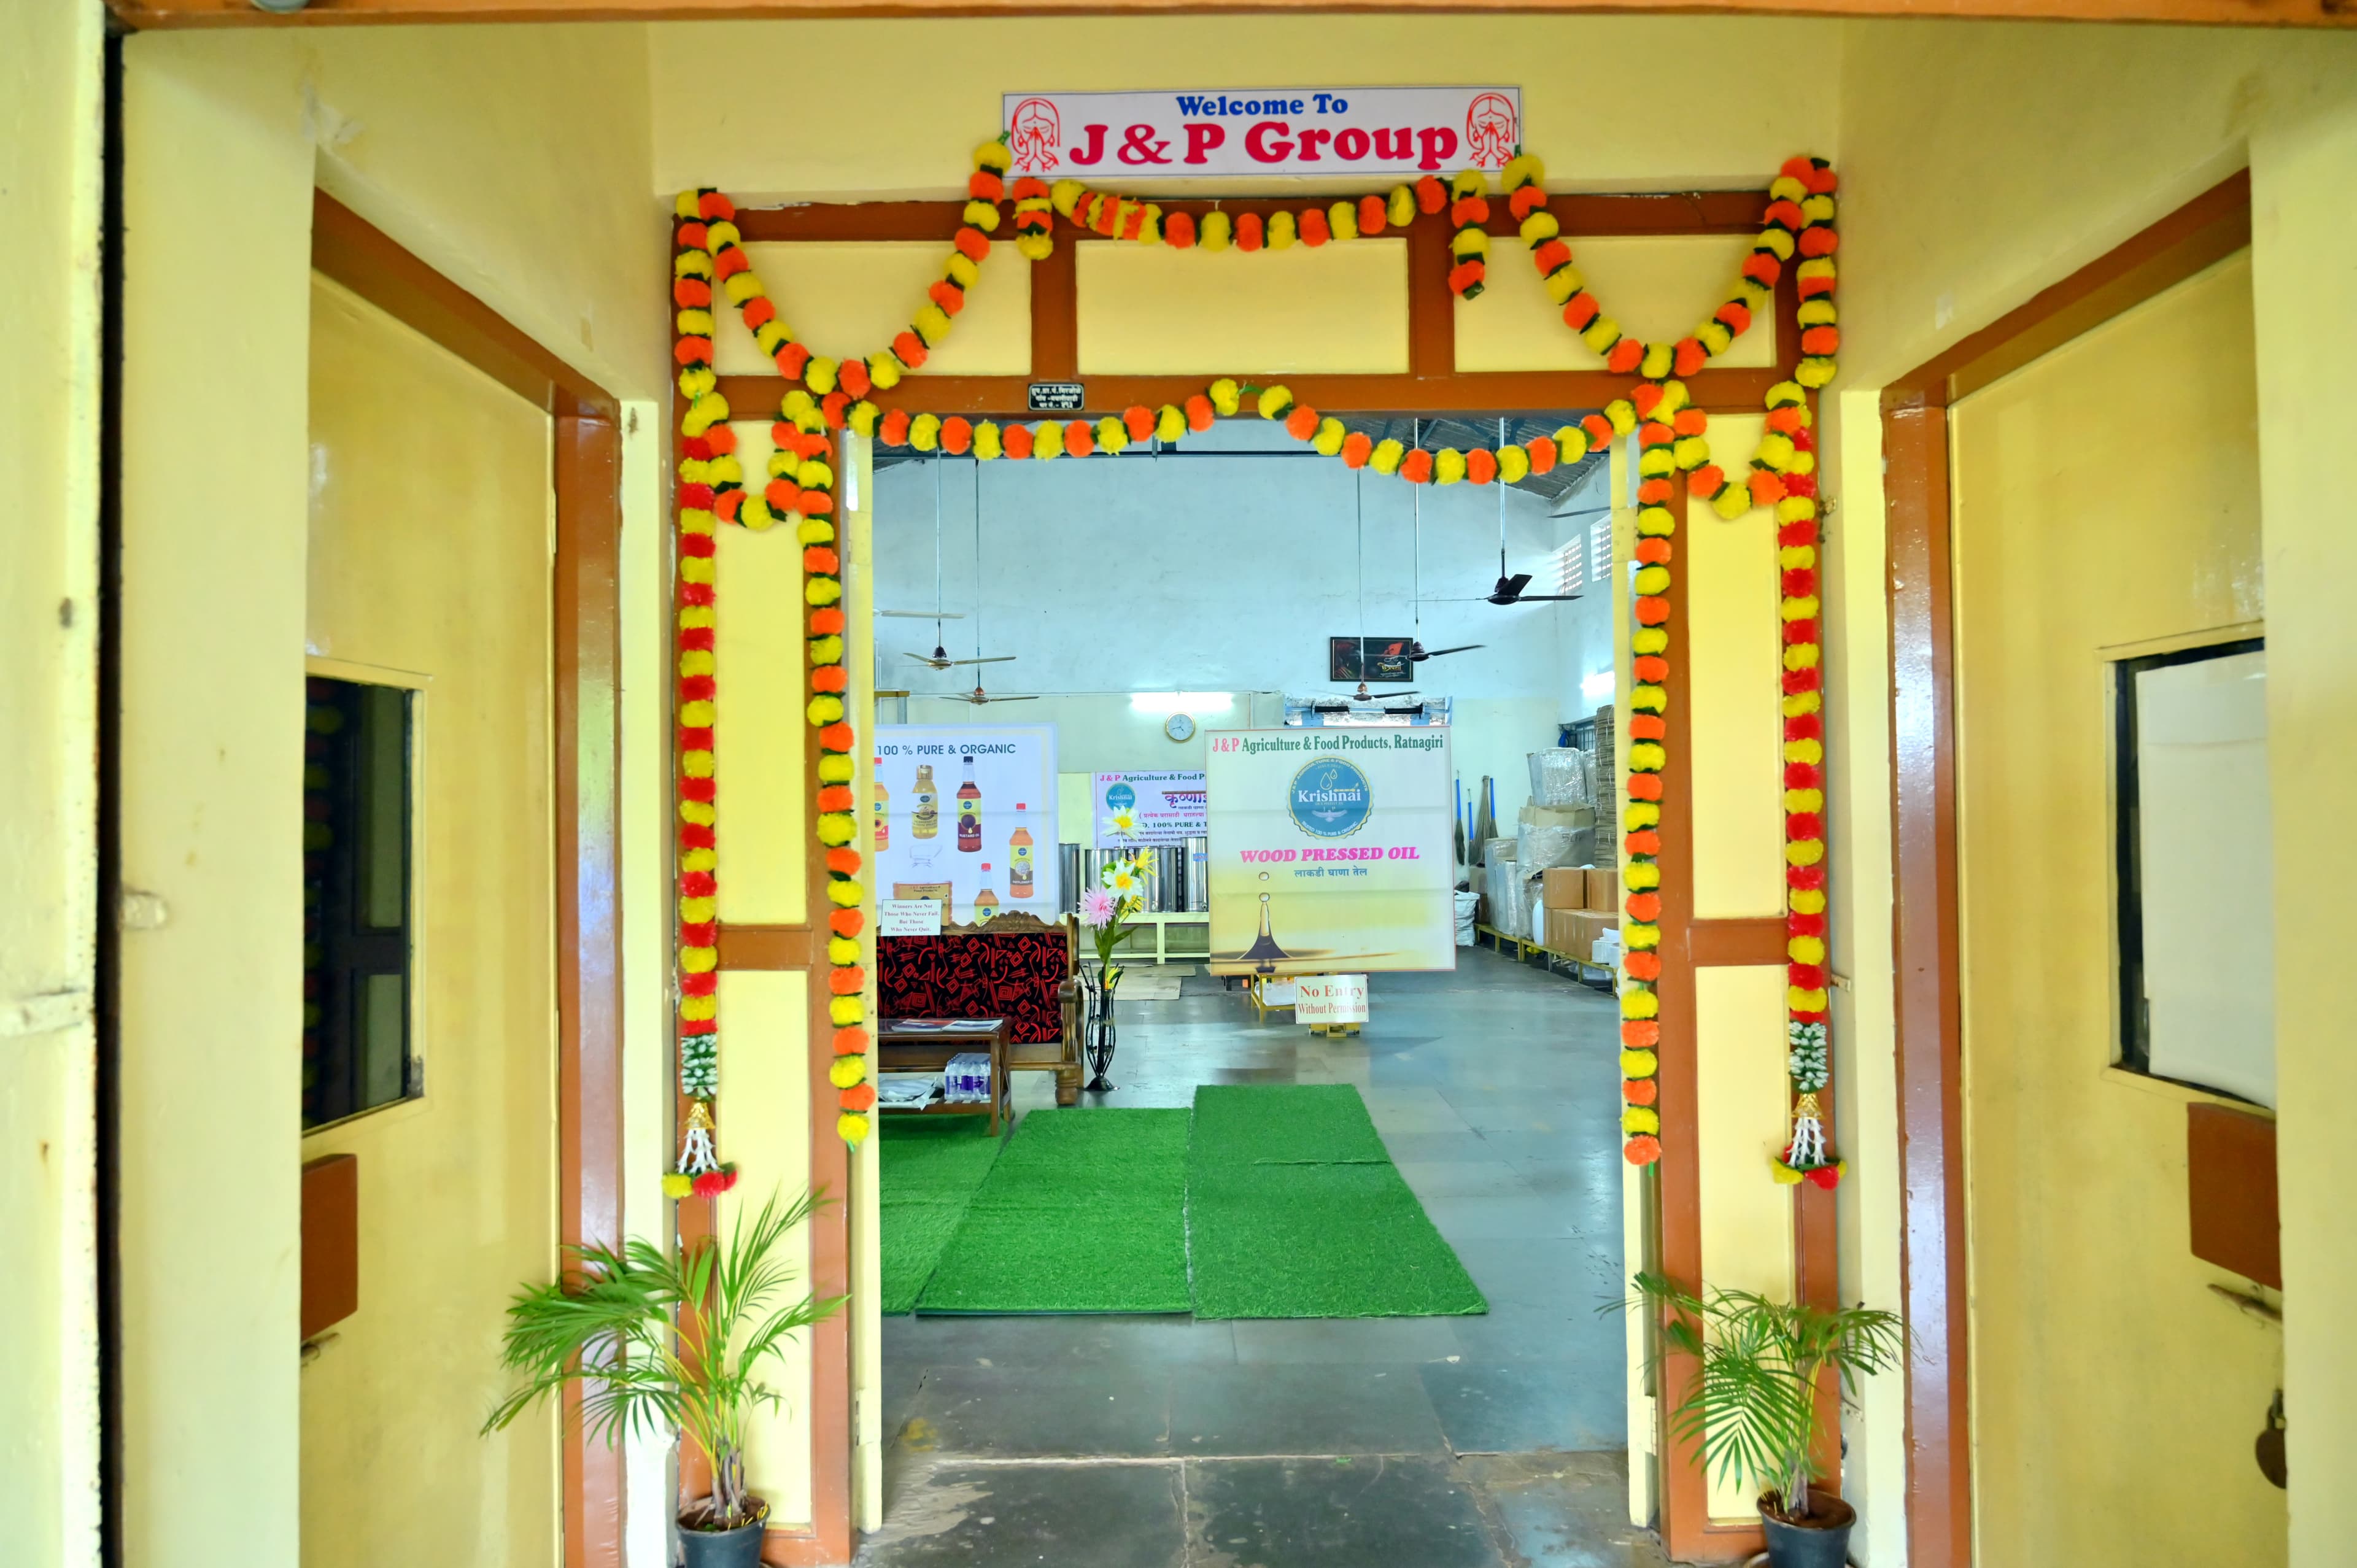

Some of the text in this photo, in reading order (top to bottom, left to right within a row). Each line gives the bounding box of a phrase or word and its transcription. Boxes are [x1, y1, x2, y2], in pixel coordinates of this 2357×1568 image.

[1176, 93, 1349, 117] Welcome To
[1244, 120, 1459, 169] Group
[877, 743, 1016, 755] 100 % PURE & ORGANIC
[1213, 734, 1443, 755] J & P Agriculture & Food Products, Ratnagiri
[1122, 774, 1167, 782] Agriculture
[1298, 789, 1361, 802] Krishnai
[1240, 847, 1420, 863] WOOD PRESSED OIL
[1294, 865, 1368, 878] लाकडी घाणा तेल
[1300, 985, 1364, 999] No Entry
[1298, 1002, 1366, 1014] Without Permission
